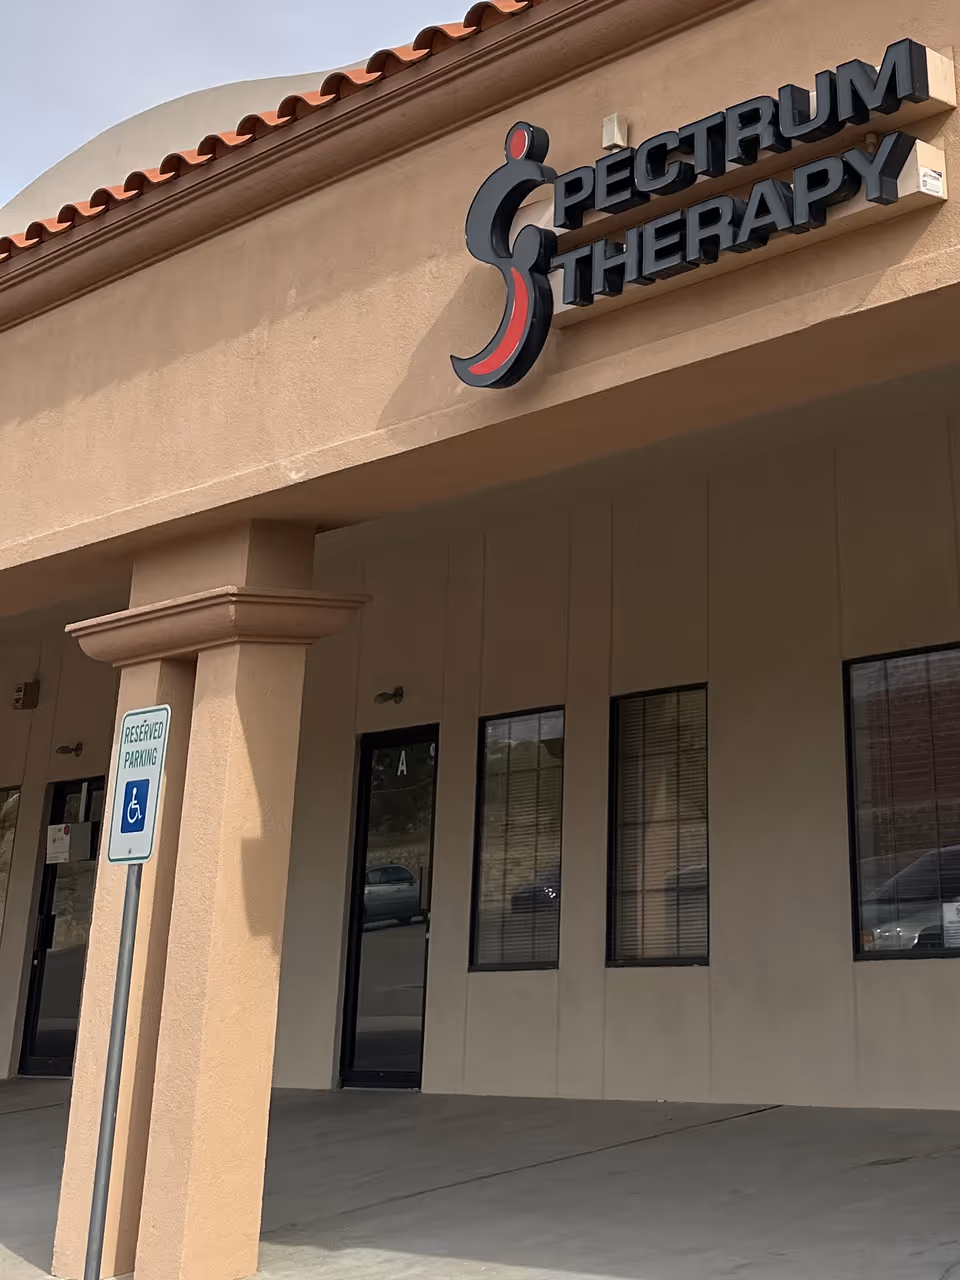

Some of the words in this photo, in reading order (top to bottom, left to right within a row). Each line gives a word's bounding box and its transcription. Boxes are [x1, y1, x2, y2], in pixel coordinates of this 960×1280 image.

[552, 131, 916, 307] THERAPY
[124, 721, 164, 744] RESERVED
[123, 747, 158, 769] PARKING
[397, 750, 407, 776] A
